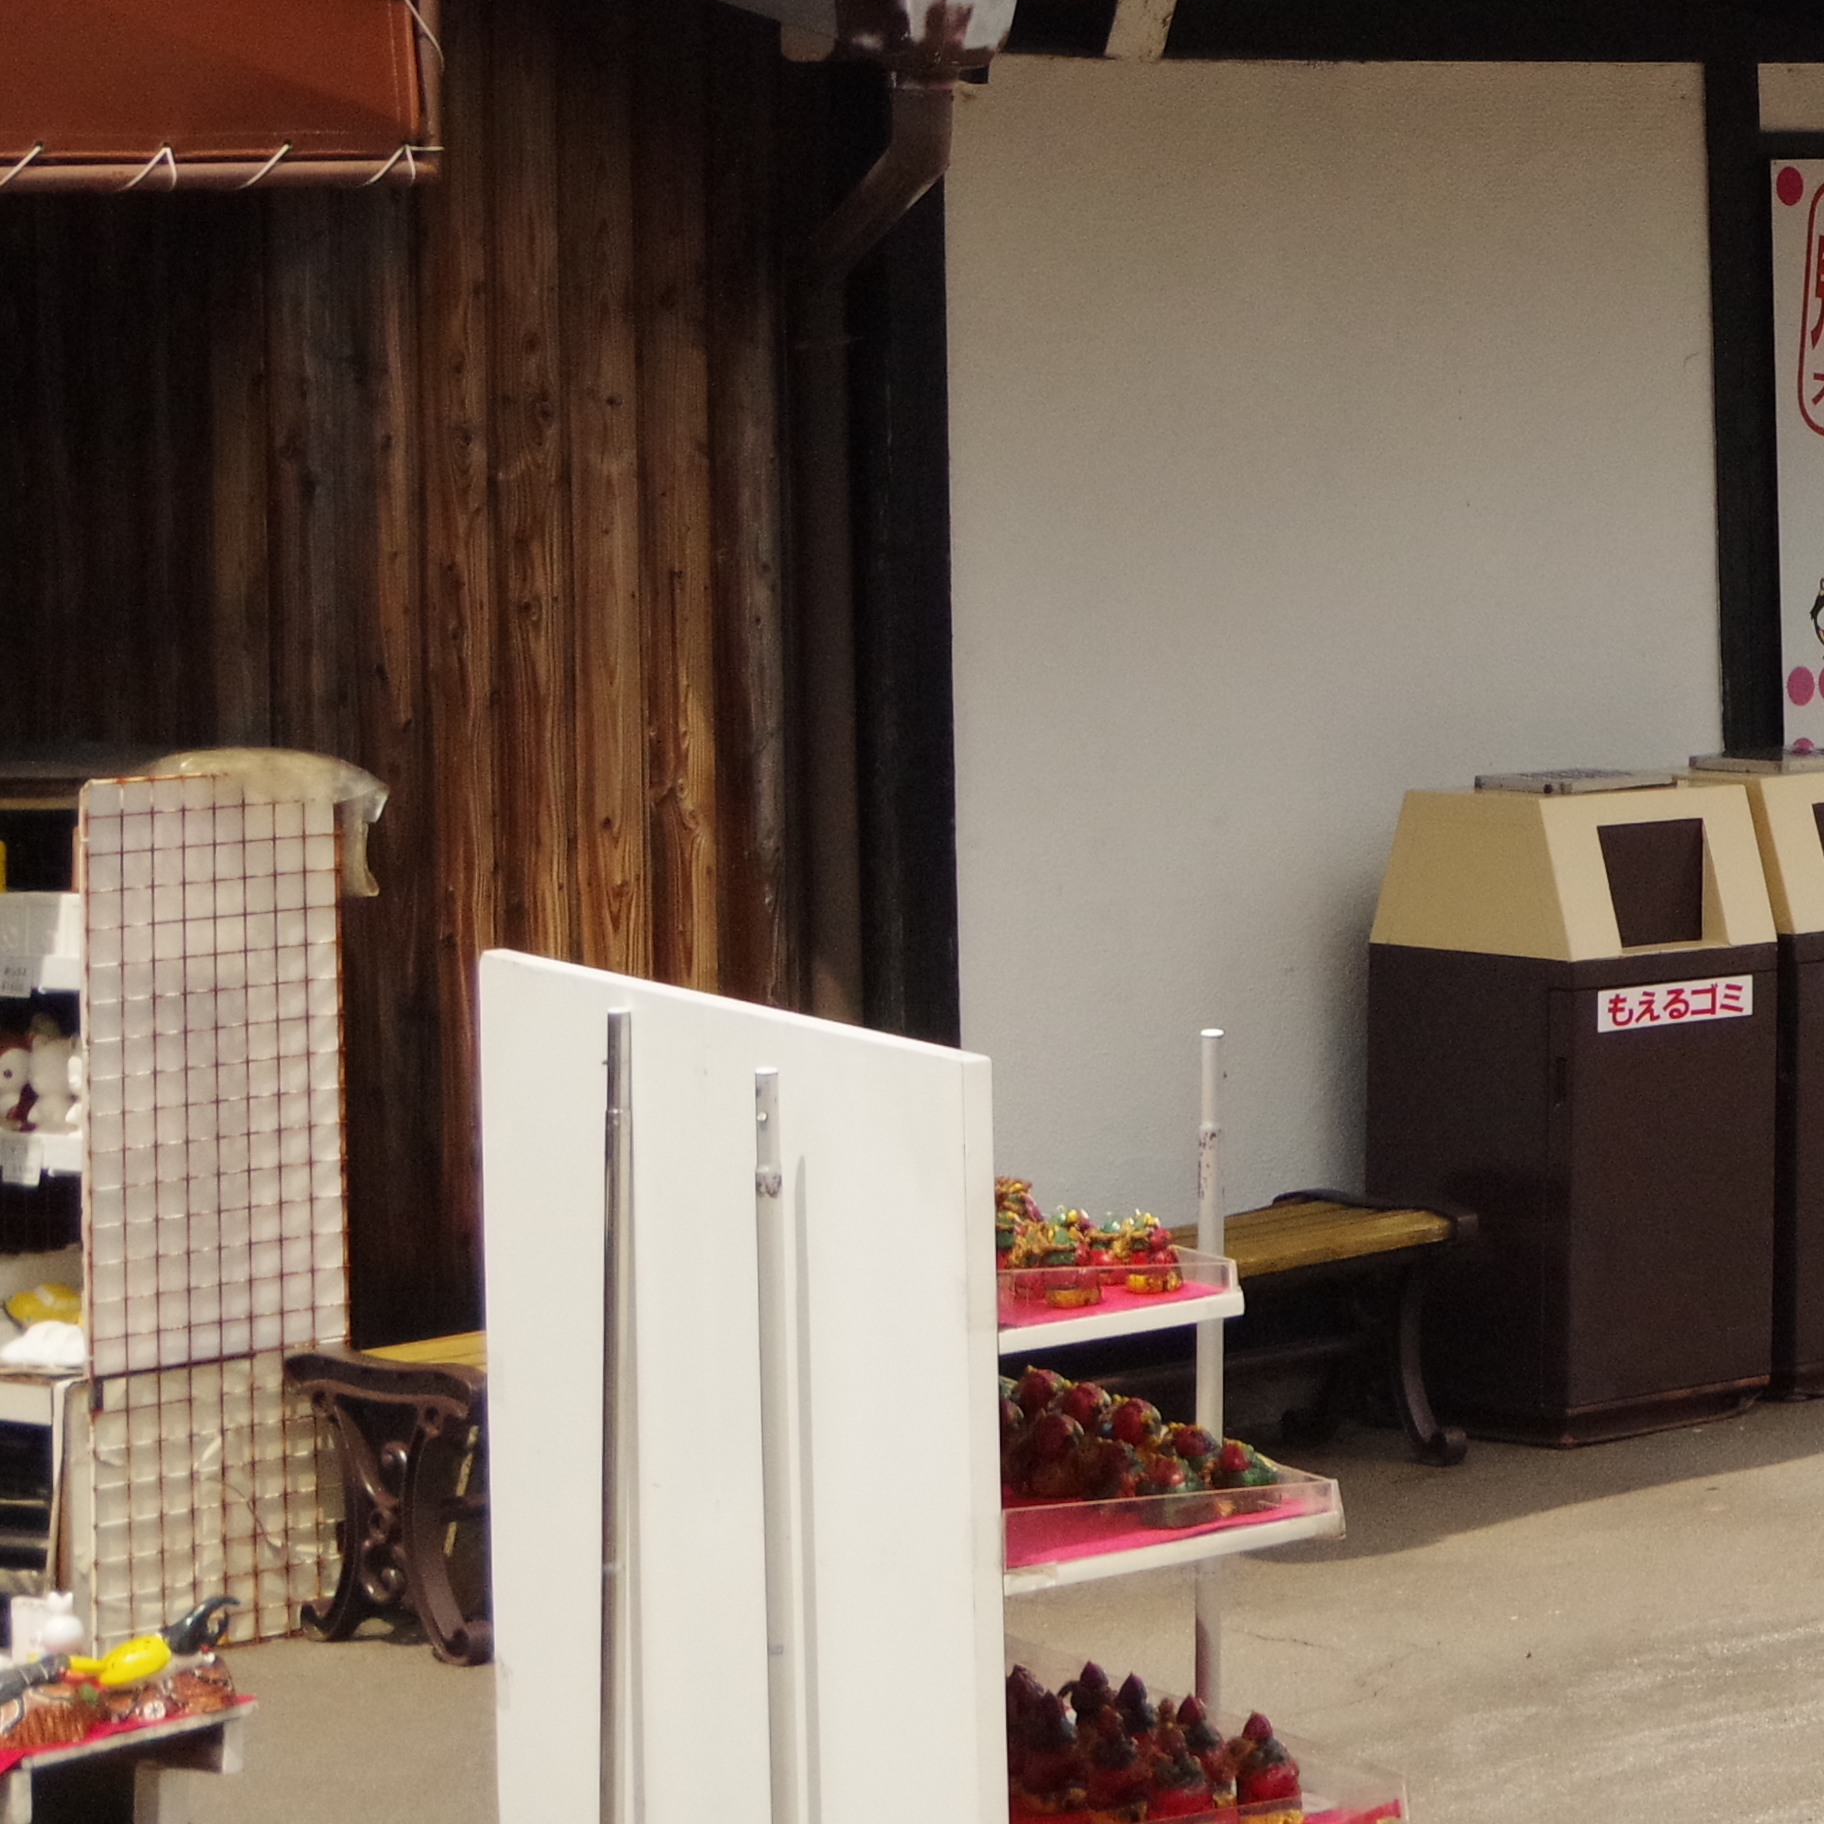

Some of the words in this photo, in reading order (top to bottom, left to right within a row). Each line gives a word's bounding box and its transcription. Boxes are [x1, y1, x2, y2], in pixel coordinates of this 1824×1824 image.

[1607, 983, 1745, 1026] もえるゴミ
